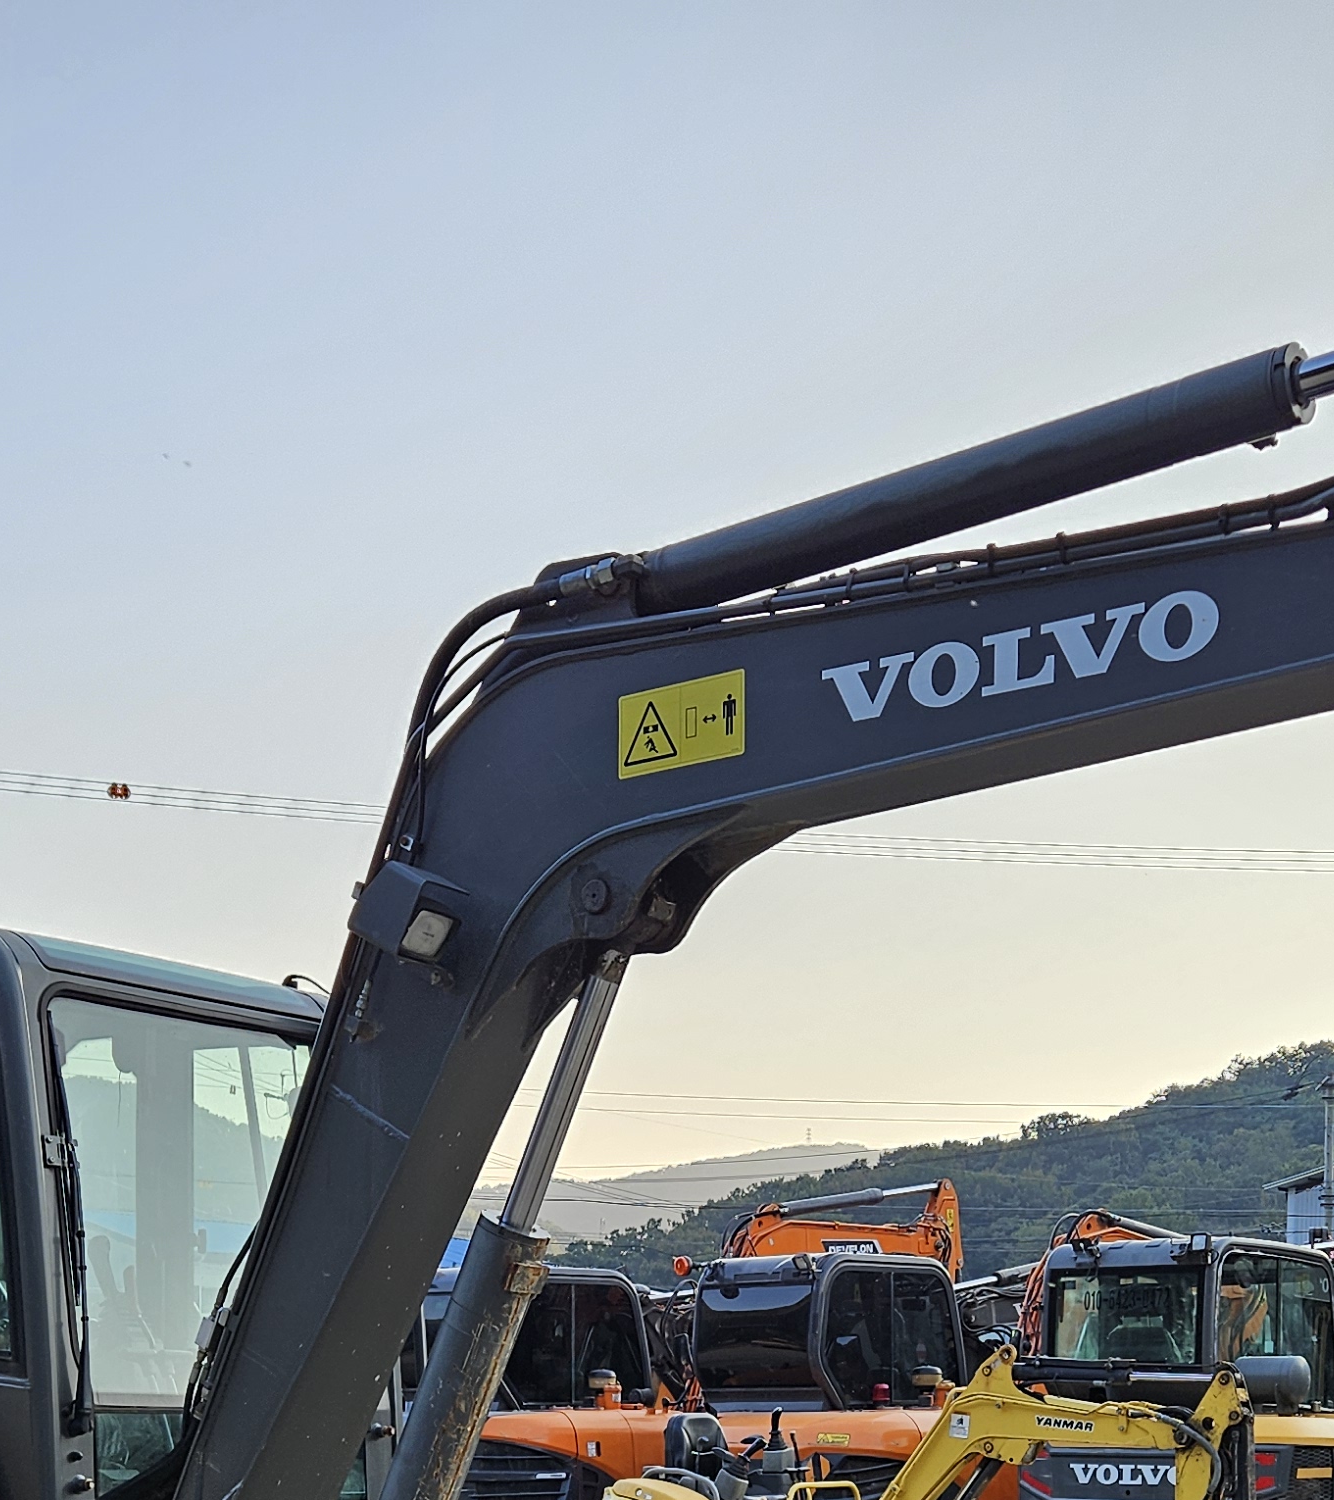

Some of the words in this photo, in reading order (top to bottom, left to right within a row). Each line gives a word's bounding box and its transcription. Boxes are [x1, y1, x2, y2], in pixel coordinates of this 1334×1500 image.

[822, 590, 1220, 722] VOLVO
[828, 1243, 874, 1253] DEVELON
[1035, 1415, 1094, 1433] YANMAR
